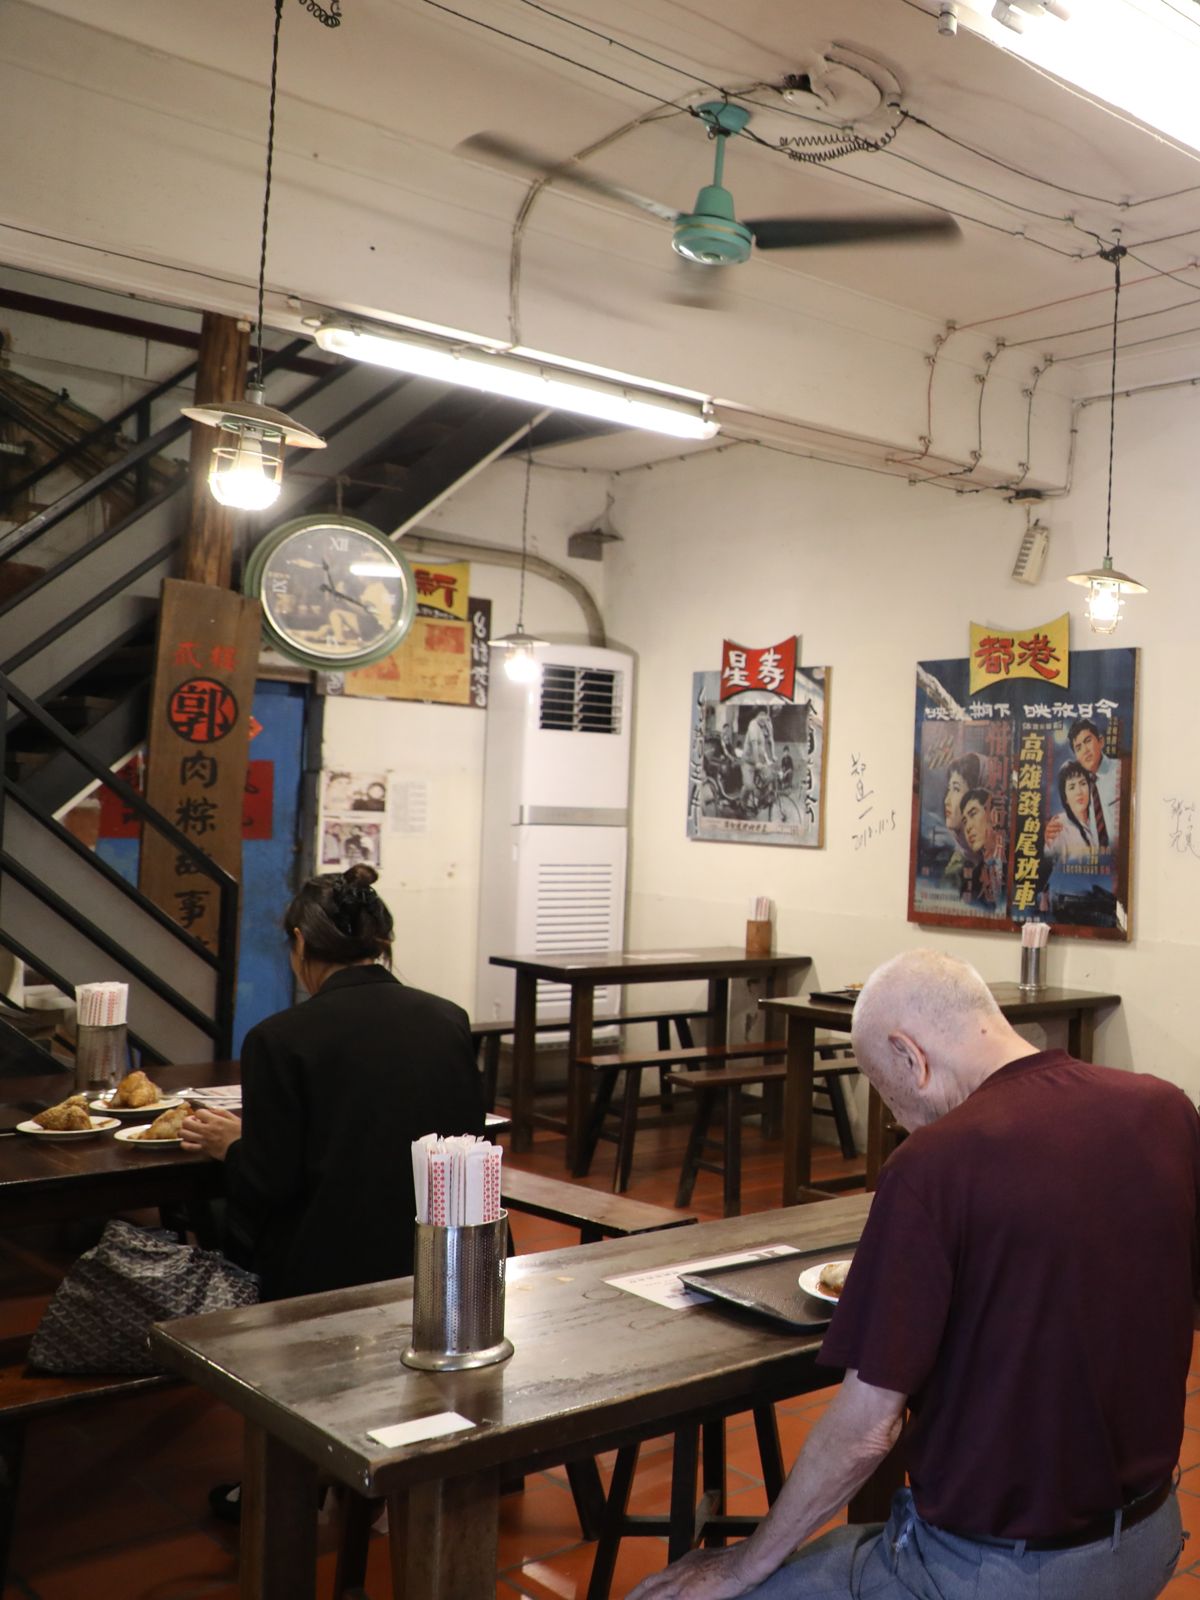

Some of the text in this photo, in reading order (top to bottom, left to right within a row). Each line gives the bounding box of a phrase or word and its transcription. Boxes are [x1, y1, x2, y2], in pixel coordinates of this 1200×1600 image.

[174, 751, 219, 928] 肉粽事
[1012, 733, 1045, 911] 高雄發的尾班車
